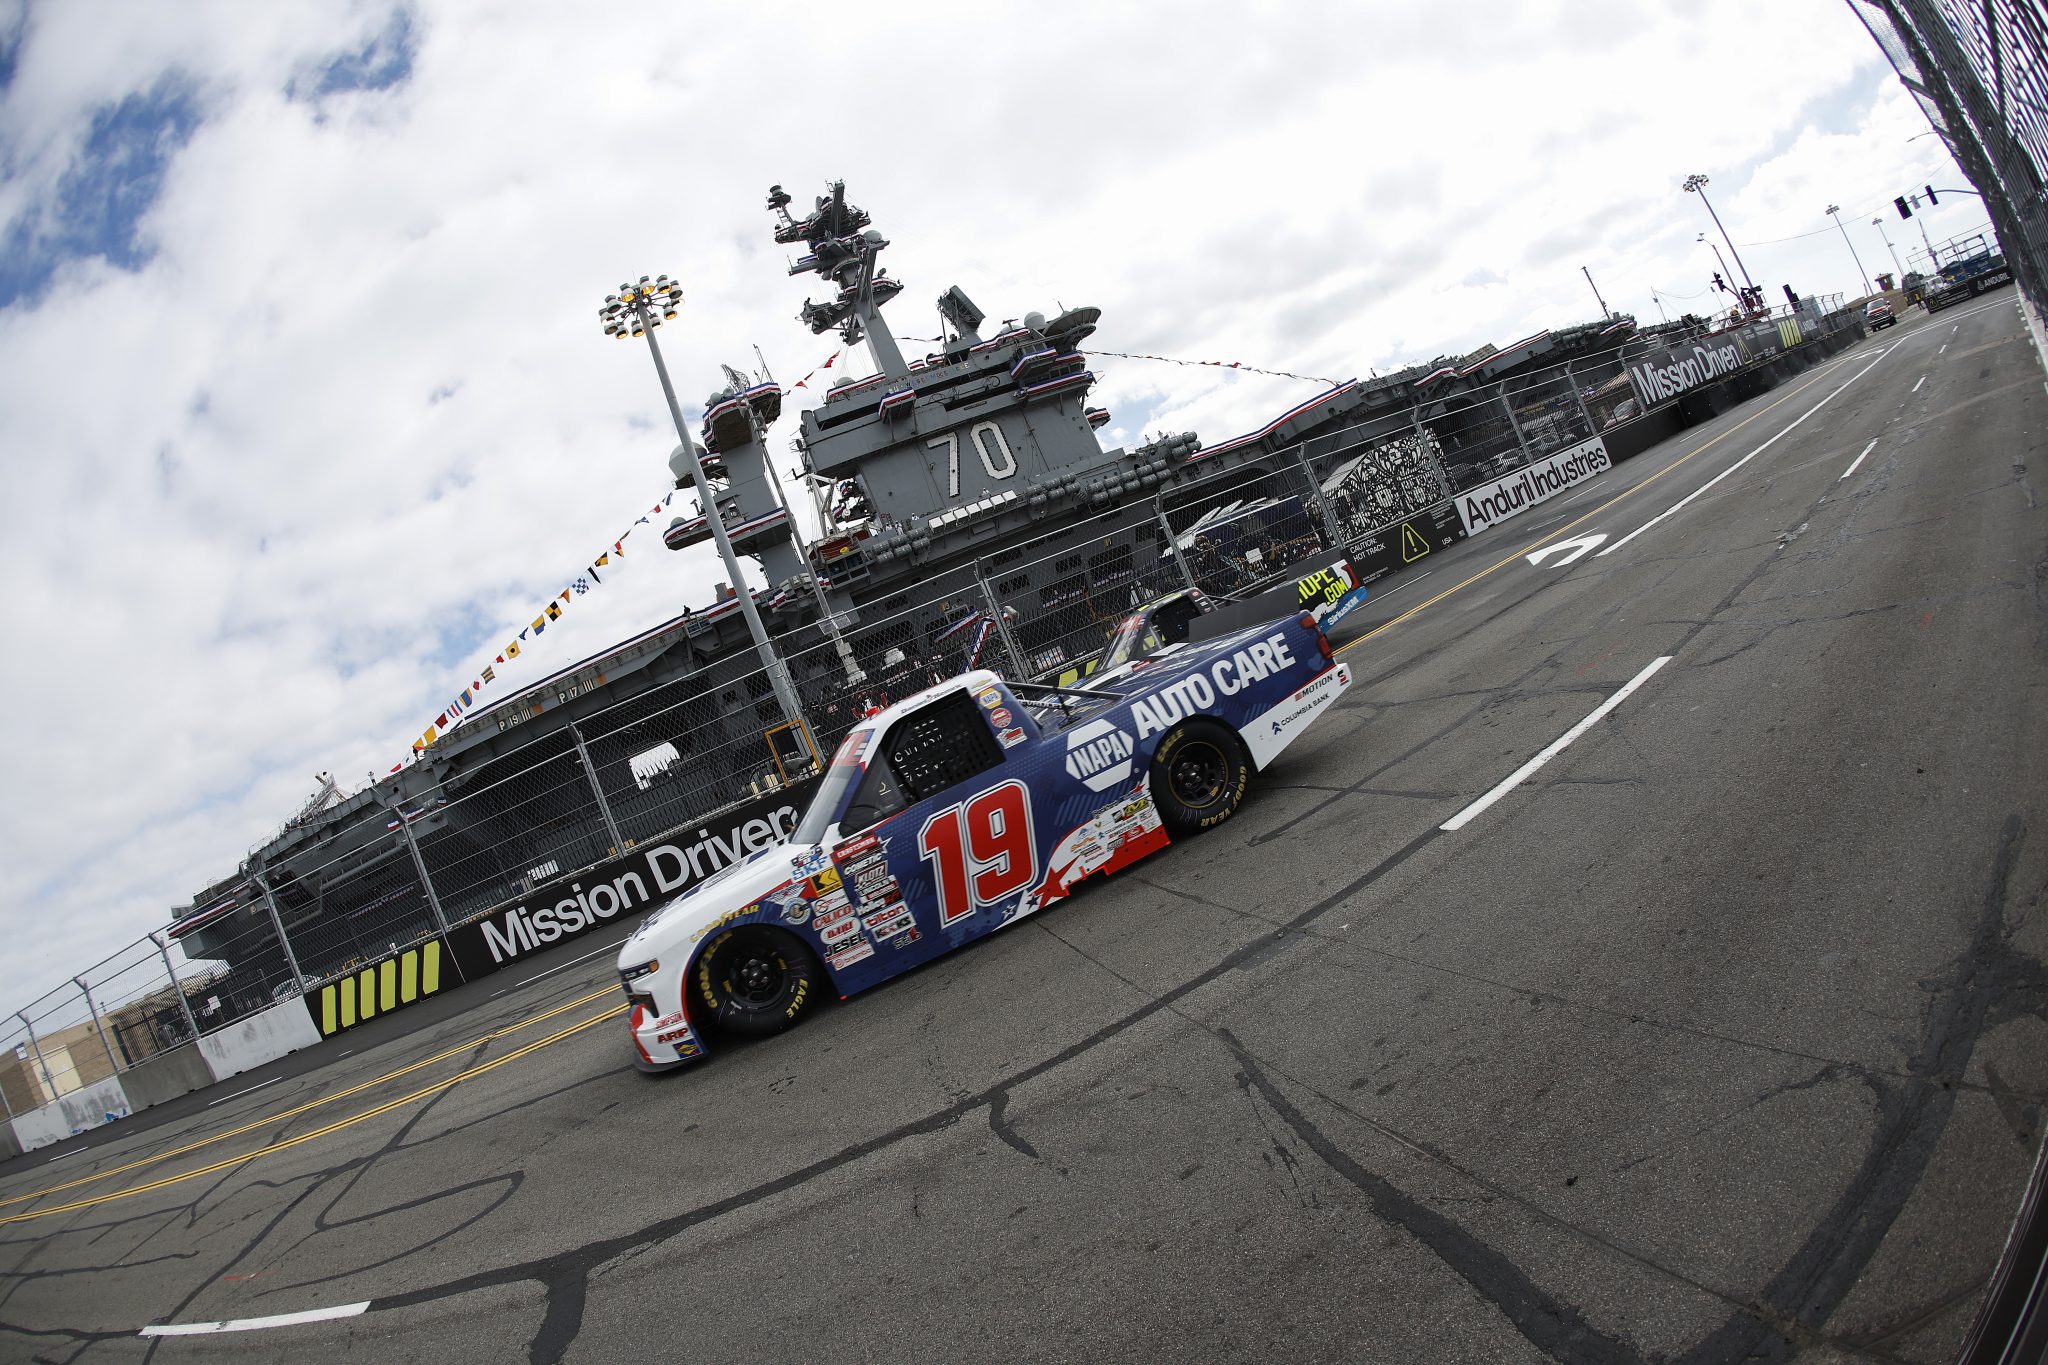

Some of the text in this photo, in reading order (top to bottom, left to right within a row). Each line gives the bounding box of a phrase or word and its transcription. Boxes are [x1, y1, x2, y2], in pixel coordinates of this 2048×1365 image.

[1632, 343, 1742, 405] Mission Driven
[926, 421, 1018, 498] 70
[1466, 447, 1607, 529] Anduril Industries
[1349, 537, 1378, 554] CAUTION:
[1353, 542, 1386, 562] HOT TRACK
[1441, 536, 1453, 545] USA
[1324, 577, 1349, 606] .COM
[1327, 595, 1359, 626] SiriusXM
[558, 692, 566, 703] P
[569, 686, 578, 698] 17
[1130, 632, 1296, 740] AUTO CARE
[1280, 692, 1330, 726] COLUMBIA BANK
[498, 721, 506, 731] P
[508, 714, 519, 726] 19
[1072, 732, 1128, 777] NAPA
[843, 853, 882, 876] COMETIC
[917, 778, 1040, 929] 19
[791, 854, 828, 880] SKF
[858, 864, 885, 882] KLOTZ
[480, 871, 649, 963] Mission
[814, 905, 852, 930] CALICO
[856, 897, 884, 914] Holley
[866, 905, 906, 927] tilton
[876, 916, 912, 938] KOOKS
[825, 932, 865, 957] JESEL
[785, 977, 809, 1019] EAGLE
[655, 1011, 683, 1028] SIMPSON
[656, 1027, 689, 1044] ARP
